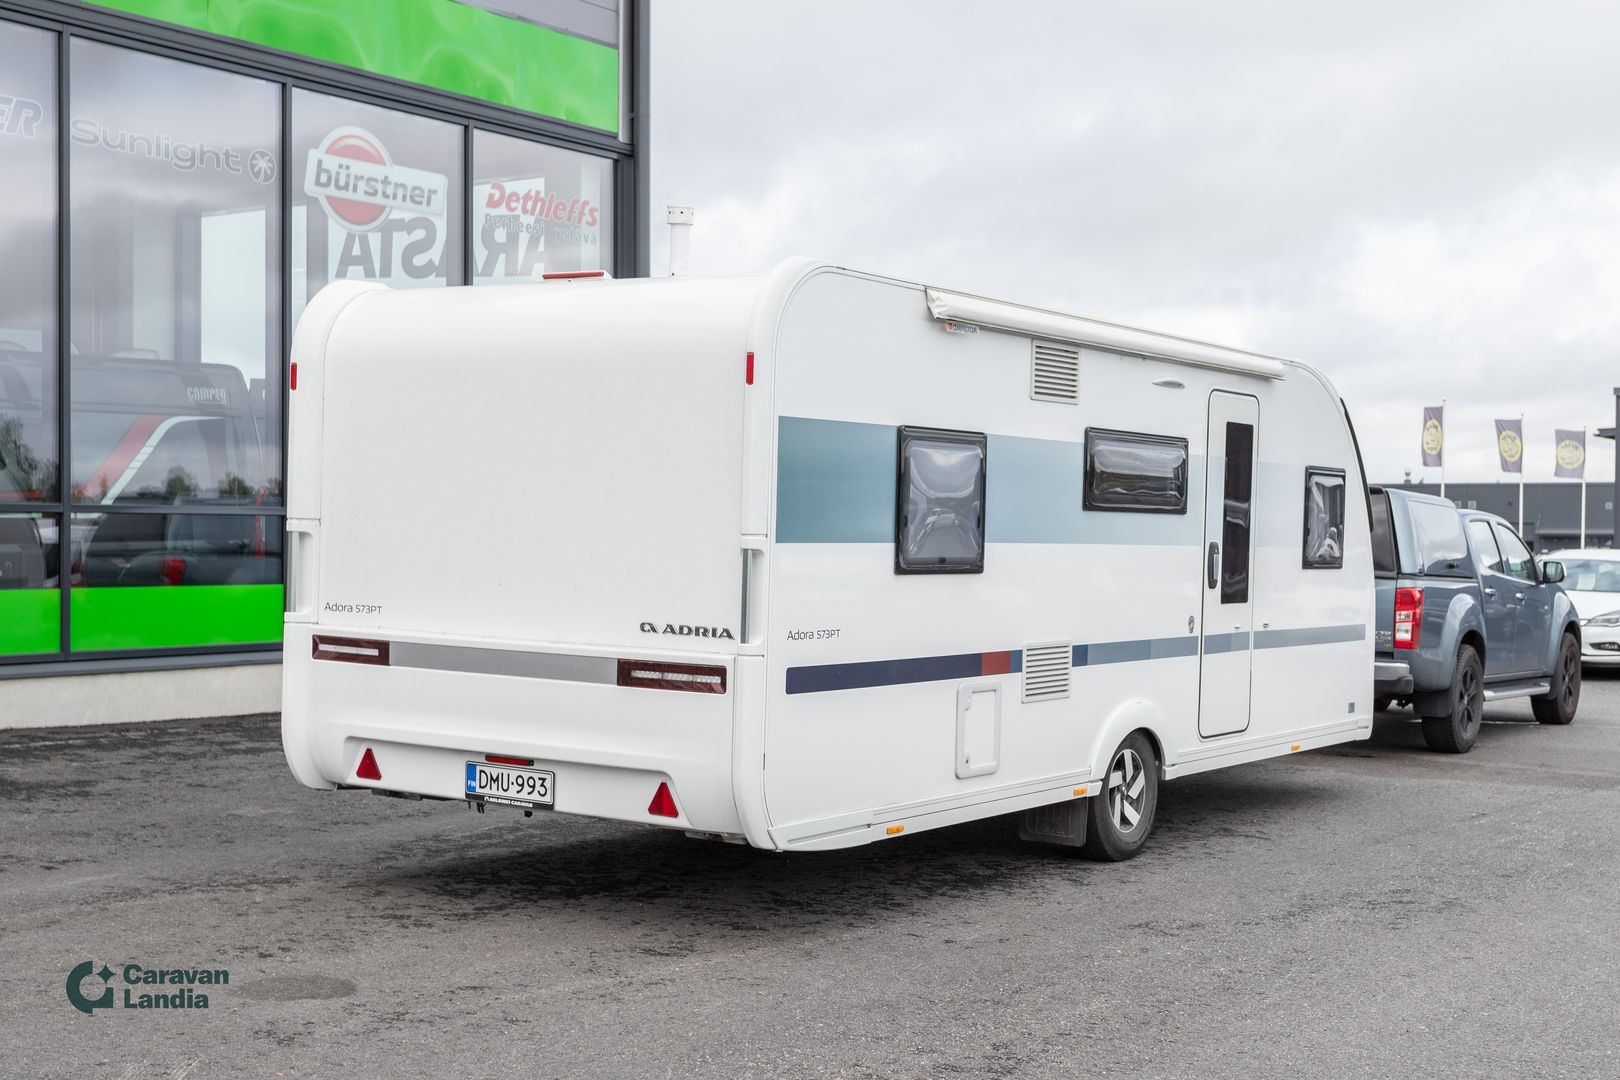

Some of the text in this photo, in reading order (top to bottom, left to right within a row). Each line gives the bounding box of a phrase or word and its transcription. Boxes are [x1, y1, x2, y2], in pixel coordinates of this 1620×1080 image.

[70, 117, 242, 172] Sunlight
[314, 159, 437, 207] bürstner
[485, 181, 598, 227] Dethleffs
[324, 602, 382, 614] Adora 573PT
[663, 623, 734, 640] ADRIA
[787, 629, 841, 640] Adora 573PT
[479, 769, 547, 797] DMU-993
